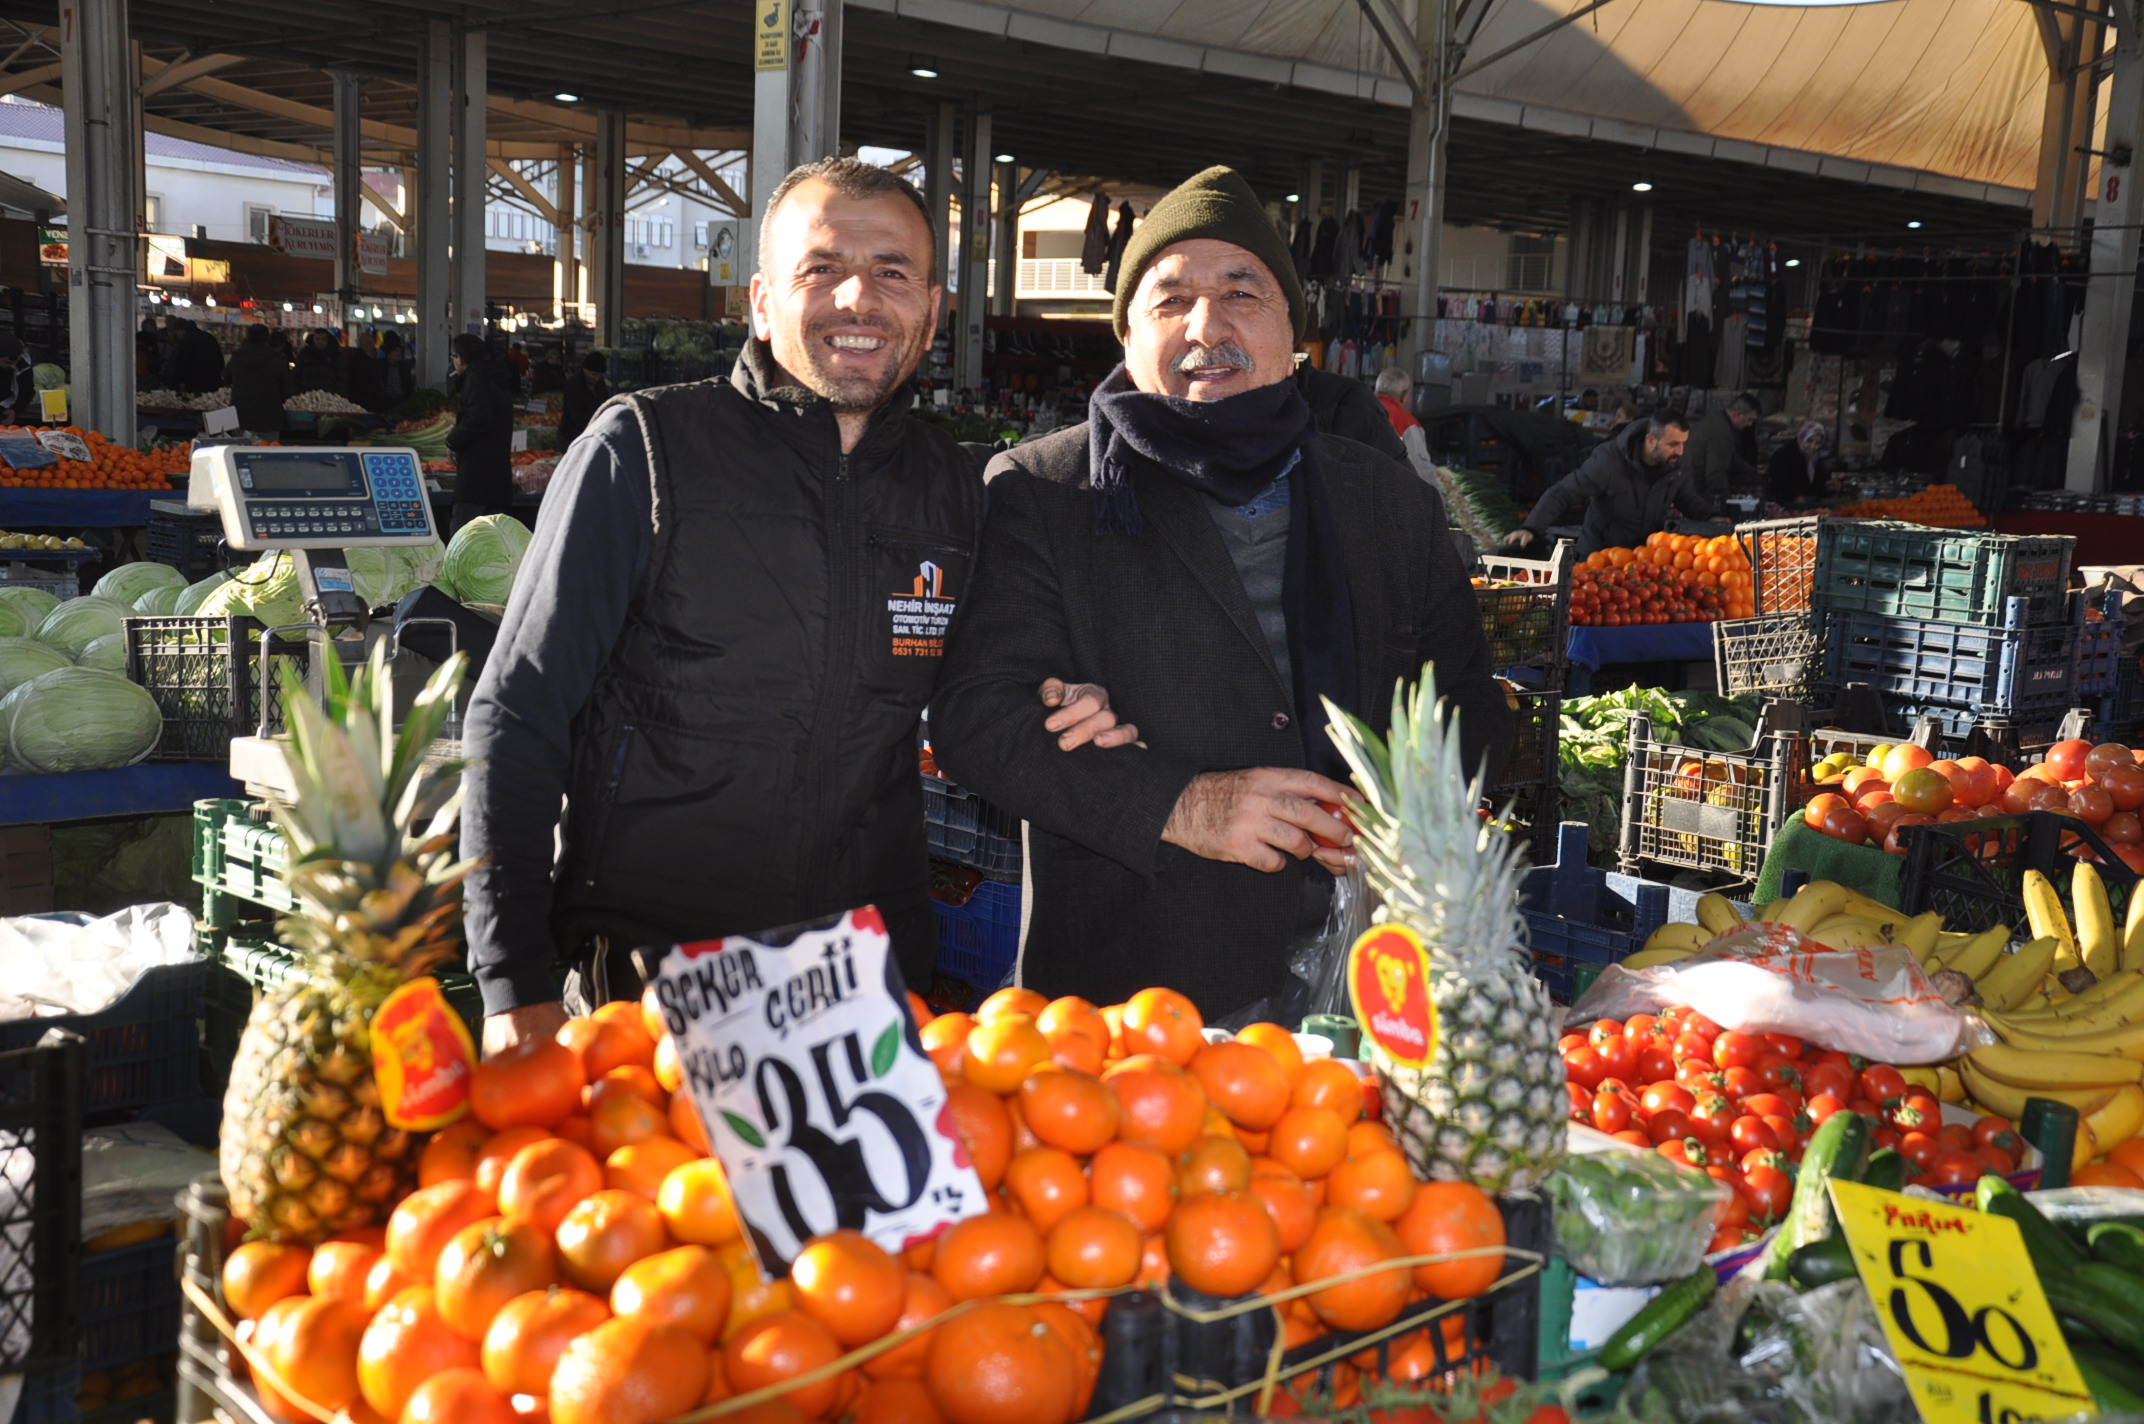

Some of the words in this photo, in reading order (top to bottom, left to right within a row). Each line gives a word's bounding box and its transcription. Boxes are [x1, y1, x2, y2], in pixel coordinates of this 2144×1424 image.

[2105, 175, 2121, 204] 8
[888, 599, 923, 613] NEHİR
[924, 600, 956, 616] İNŞAAT
[892, 614, 931, 625] OTOMOTİV
[892, 638, 928, 647] BURHAN
[892, 647, 912, 656] 0531
[915, 648, 929, 656] 731
[754, 1030, 932, 1248] 35
